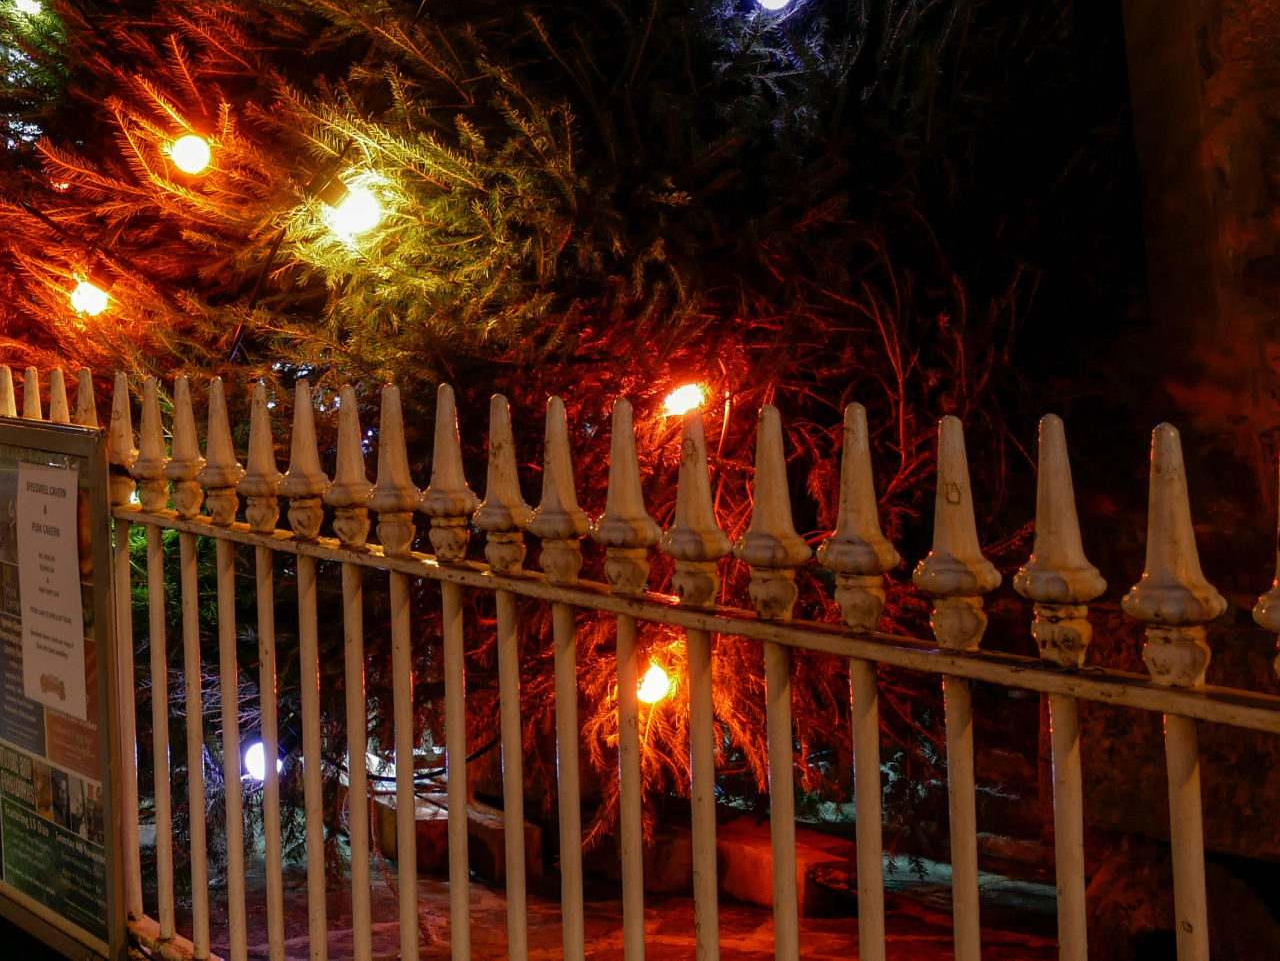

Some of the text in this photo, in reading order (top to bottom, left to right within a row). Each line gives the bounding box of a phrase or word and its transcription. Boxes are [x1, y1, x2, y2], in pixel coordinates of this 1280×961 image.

[26, 481, 67, 498] SPEEDWELL CAVERN
[43, 504, 47, 514] &
[31, 521, 60, 537] PEAK CAVERN
